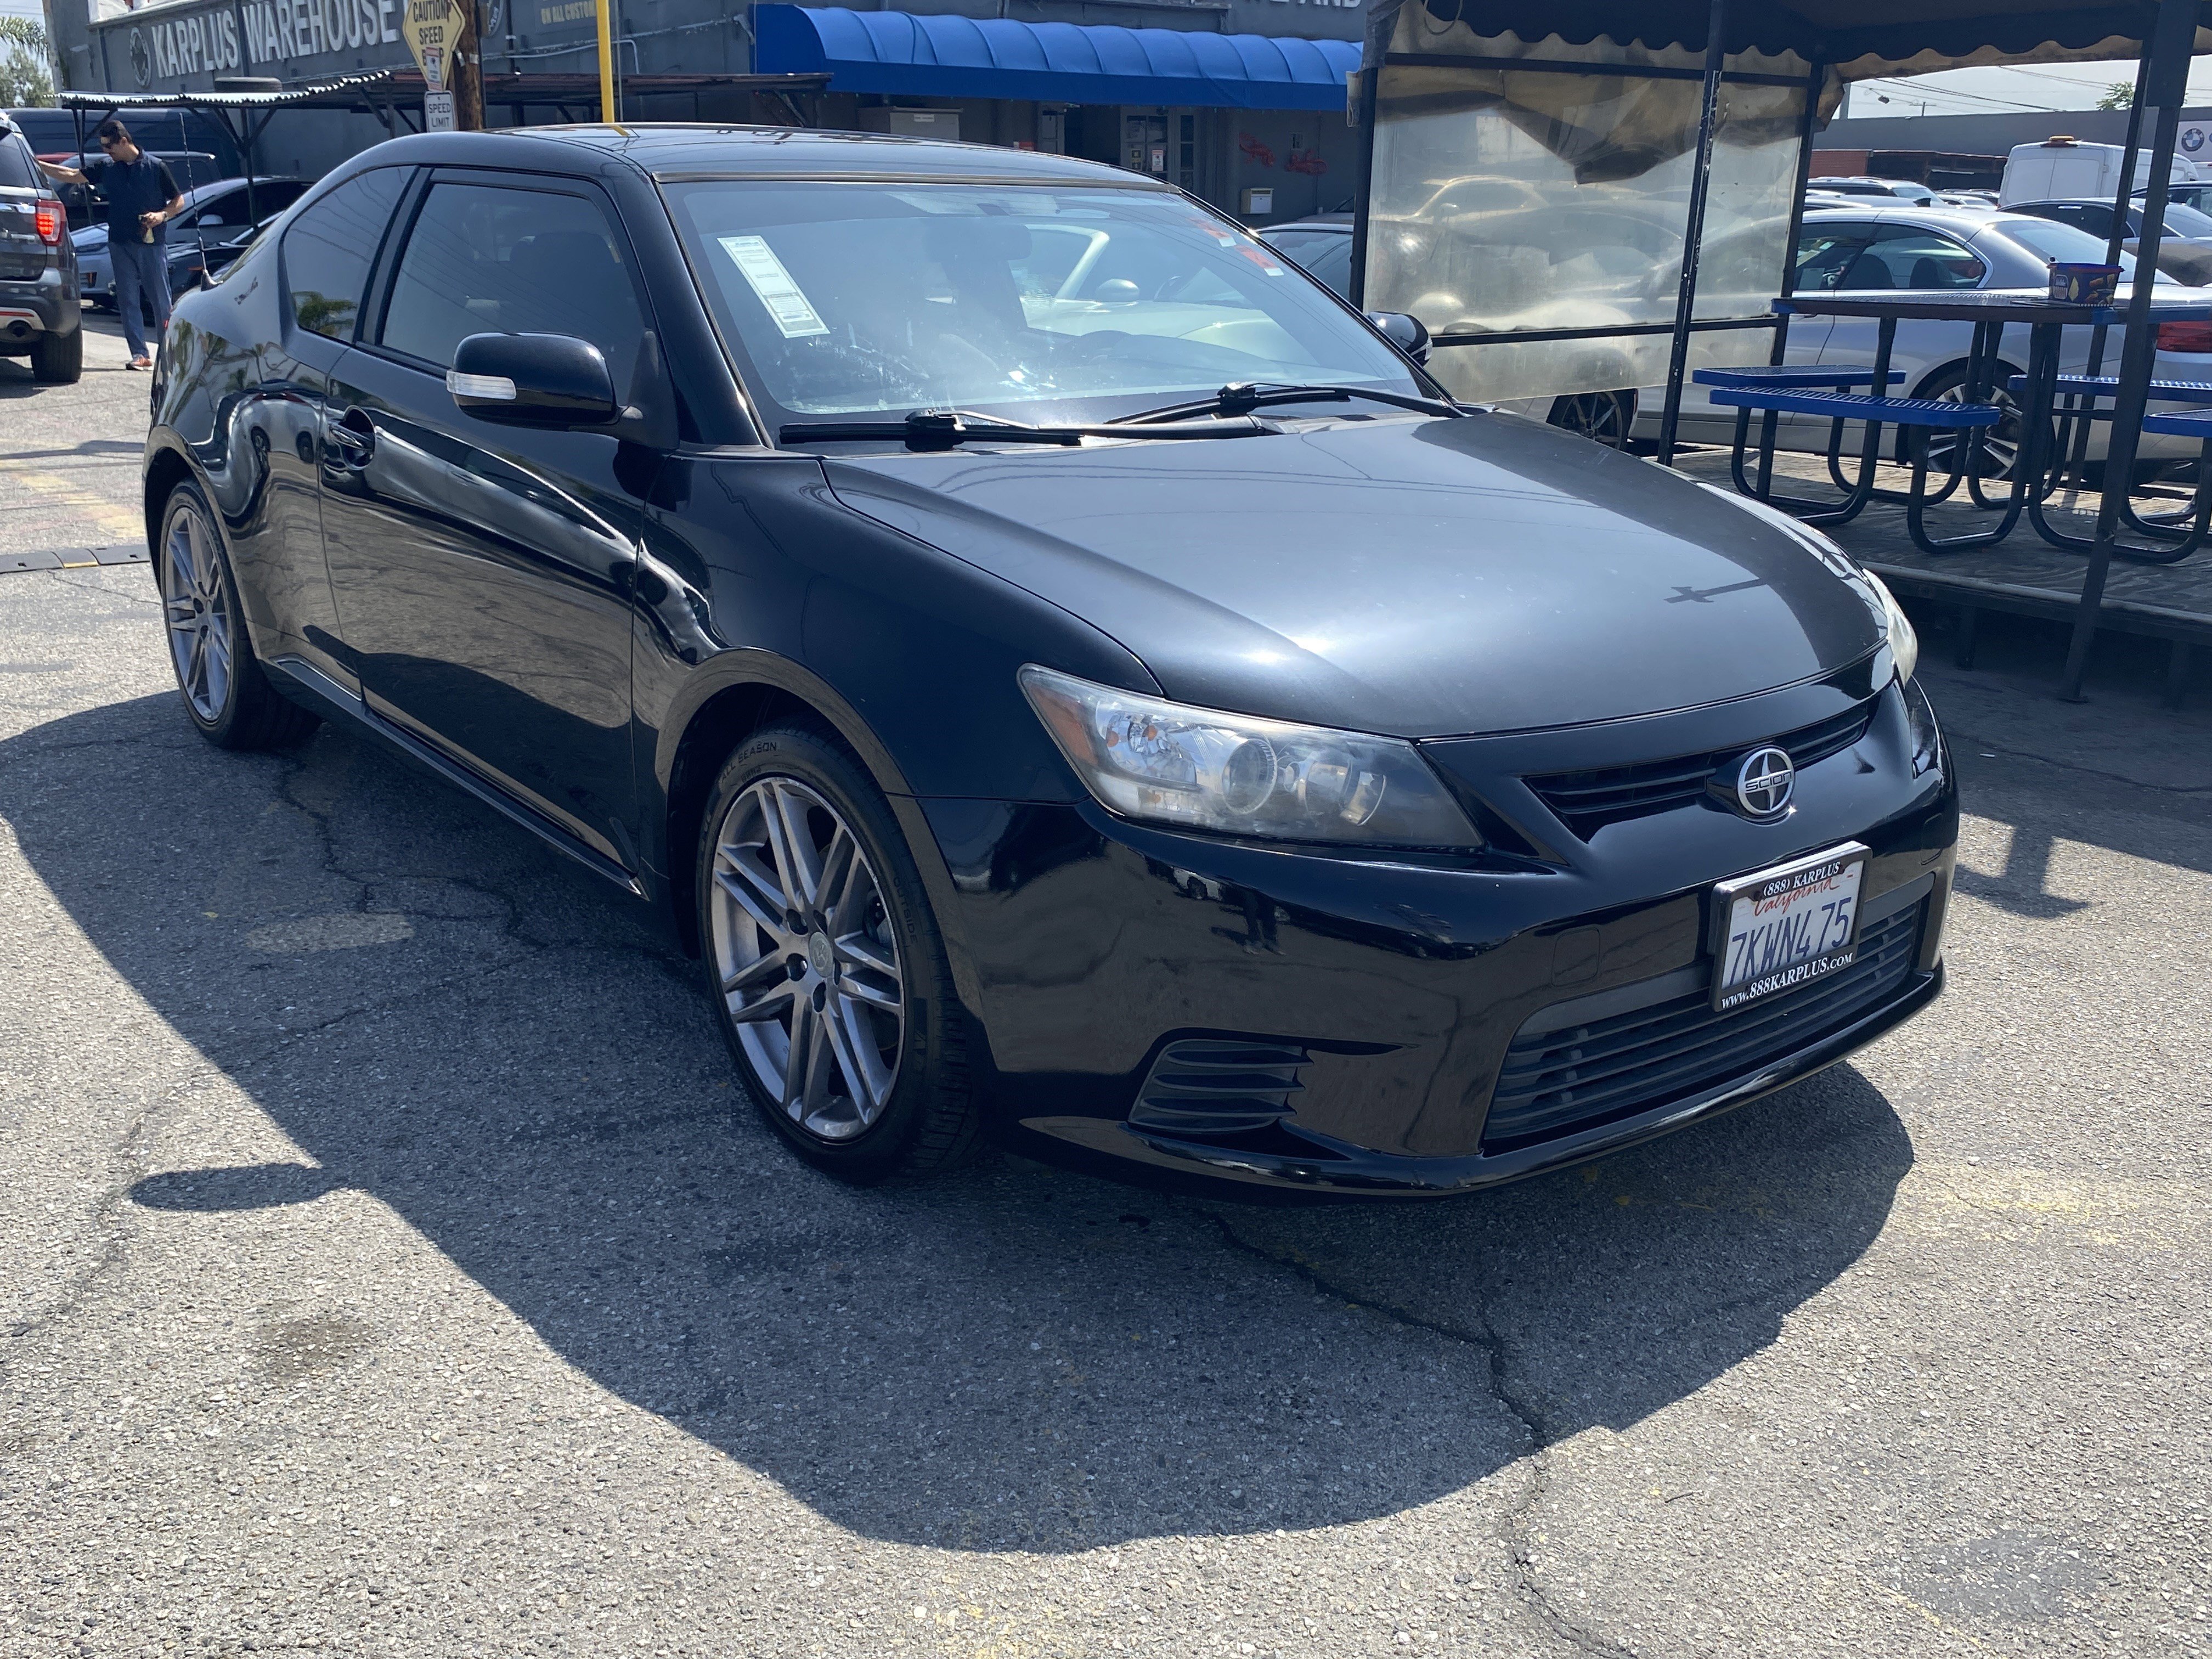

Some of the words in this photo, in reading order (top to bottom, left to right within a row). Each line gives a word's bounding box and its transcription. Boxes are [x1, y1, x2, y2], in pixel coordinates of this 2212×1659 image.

[413, 0, 447, 22] CAUTION
[151, 10, 238, 78] KARPLUS
[242, 0, 399, 64] WAREHOUSE
[419, 26, 443, 45] SPEED
[422, 47, 444, 66] BP
[428, 103, 450, 113] SPEED
[432, 117, 449, 128] LIMIT
[738, 741, 777, 764] SEASON
[1763, 878, 1791, 896] (888)
[1793, 861, 1841, 888] KARPLUS
[1729, 896, 1852, 986] 7KWN475
